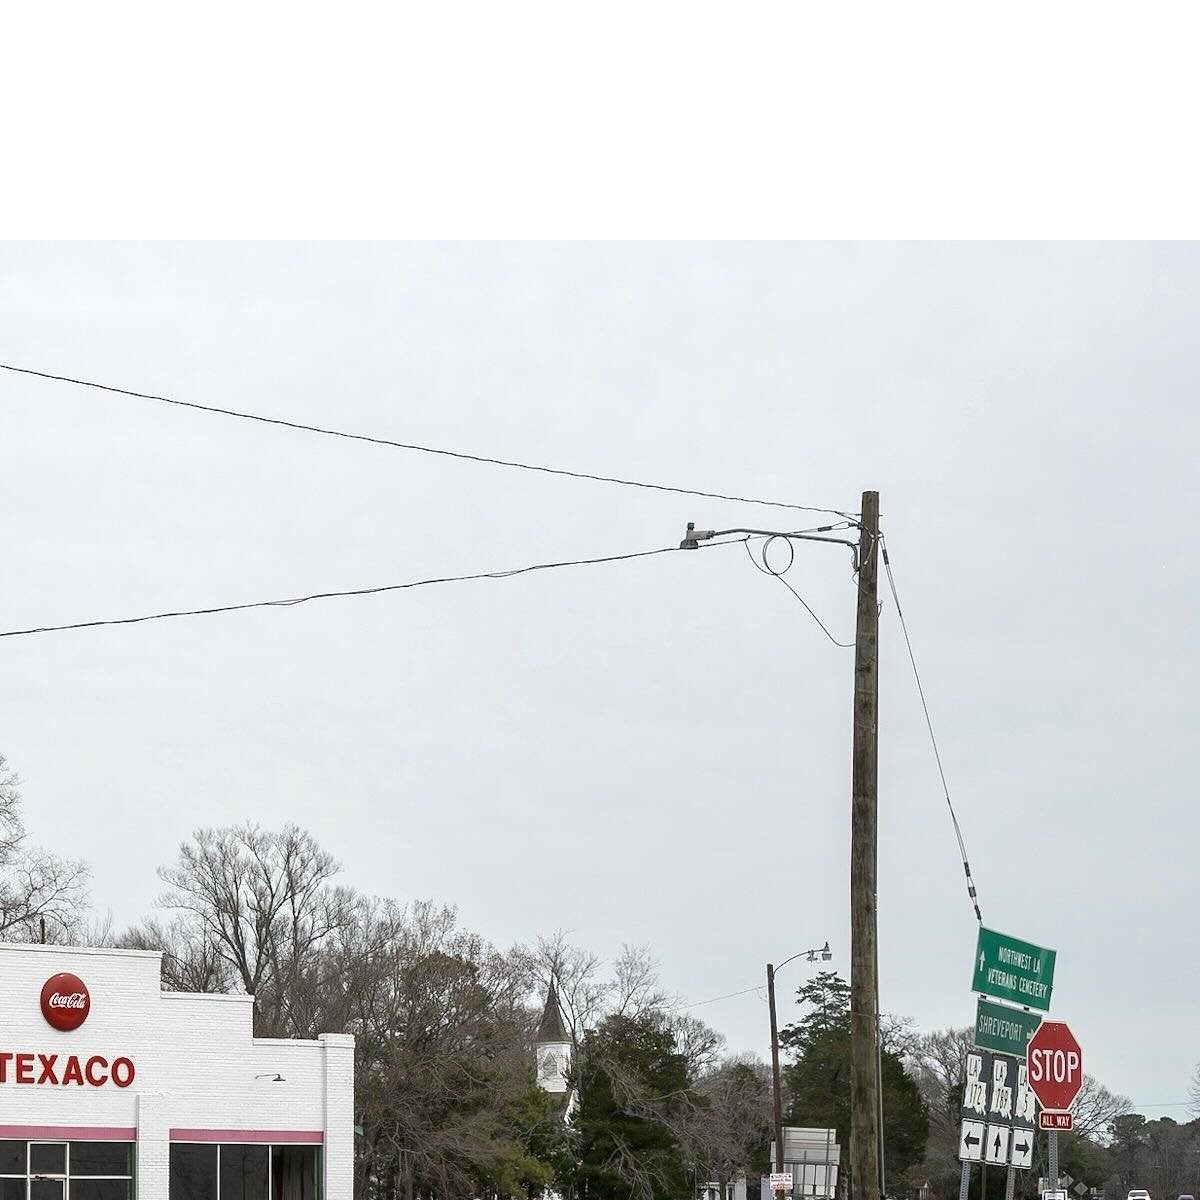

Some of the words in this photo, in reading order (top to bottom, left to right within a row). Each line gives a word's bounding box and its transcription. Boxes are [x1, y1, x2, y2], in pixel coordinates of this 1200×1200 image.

[998, 946, 1031, 969] NORTHWEST
[1033, 959, 1041, 974] LA
[988, 968, 1017, 990] VETERANS
[1019, 976, 1048, 998] CEMETERY
[979, 1015, 1022, 1041] SHREVEPORT
[1031, 1048, 1079, 1083] STOP
[970, 1083, 982, 1105] 172
[995, 1088, 1009, 1109] 789
[1042, 1116, 1054, 1126] ALL
[1056, 1116, 1070, 1127] WAY
